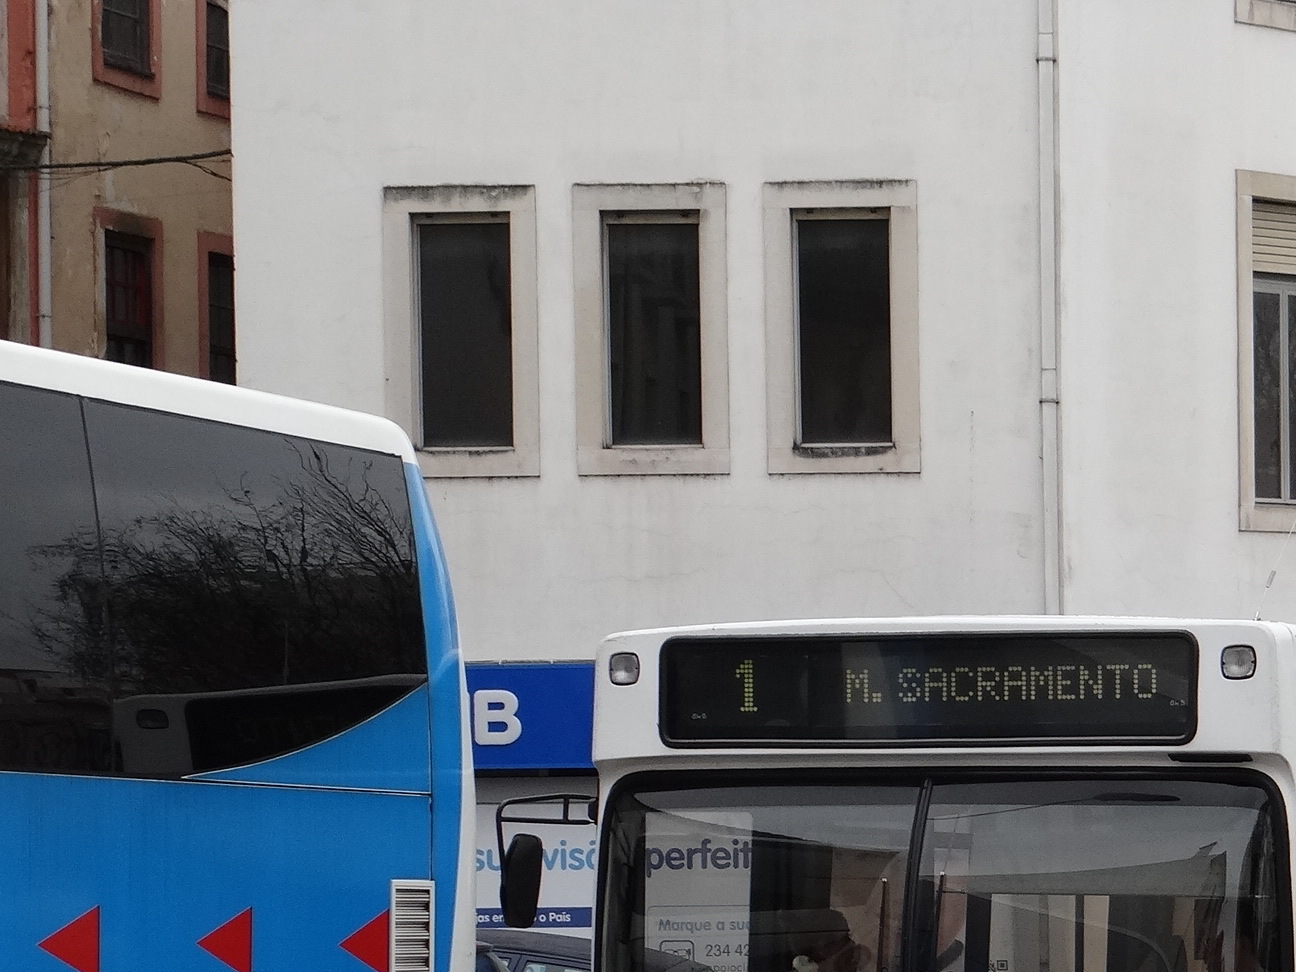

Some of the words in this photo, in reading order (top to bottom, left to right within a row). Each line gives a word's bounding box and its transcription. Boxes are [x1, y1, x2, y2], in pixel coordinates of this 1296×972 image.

[735, 659, 758, 712] 1
[845, 668, 881, 703] M.
[898, 664, 1158, 702] SACRAMENTO
[646, 838, 752, 879] perfeit
[549, 912, 571, 923] País
[658, 919, 712, 934] Marque
[716, 920, 725, 931] a
[705, 944, 730, 957] 234
[735, 944, 750, 957] 42
